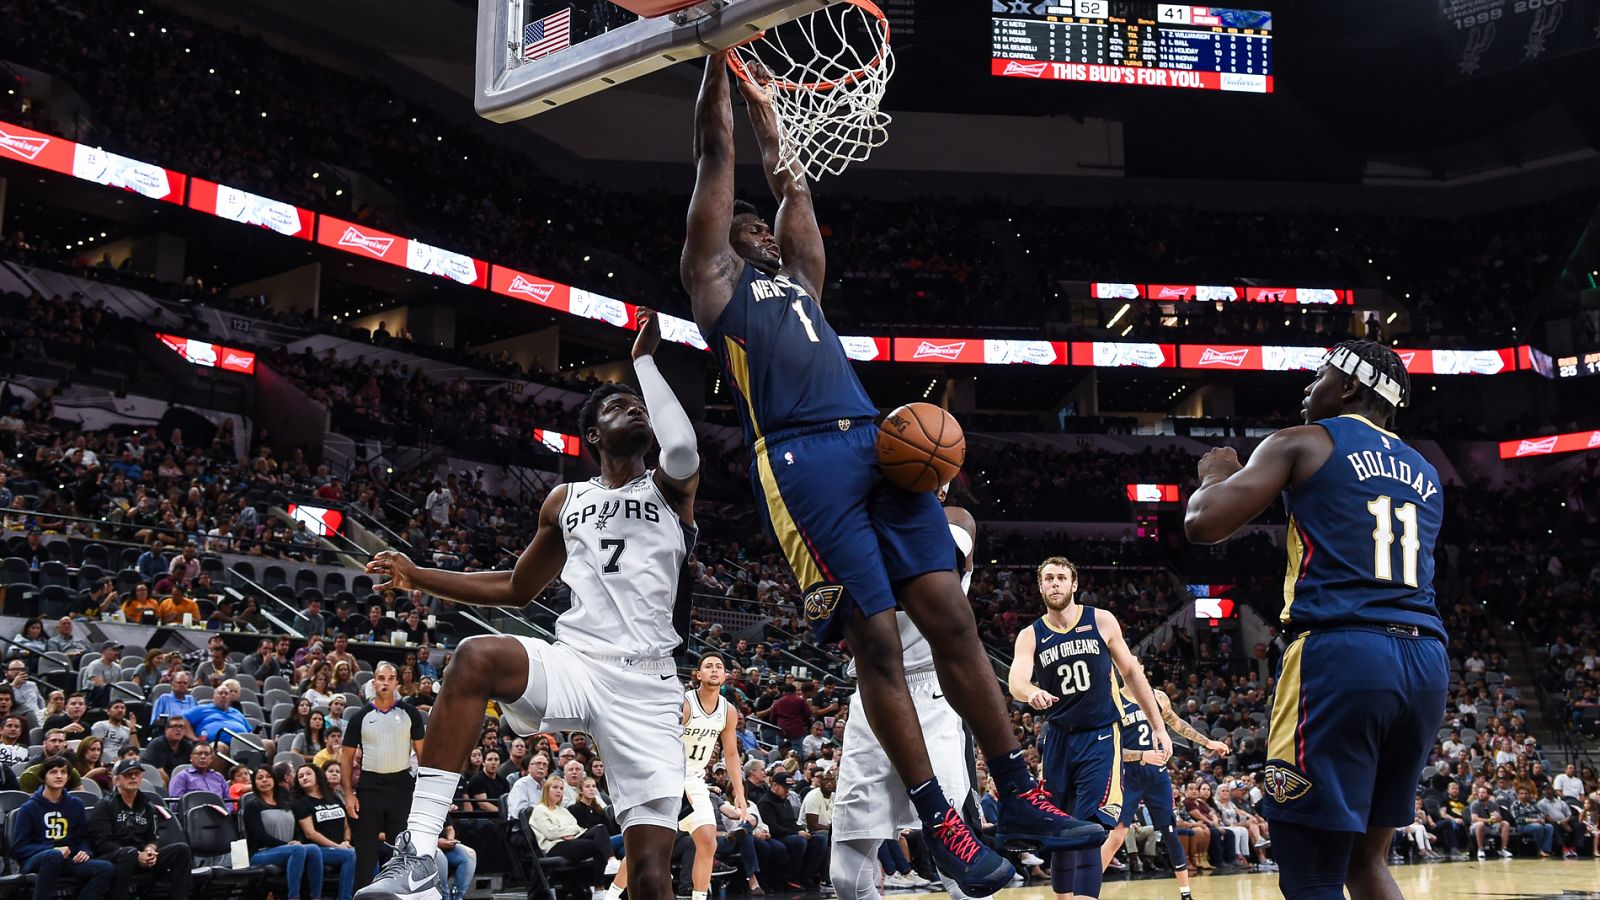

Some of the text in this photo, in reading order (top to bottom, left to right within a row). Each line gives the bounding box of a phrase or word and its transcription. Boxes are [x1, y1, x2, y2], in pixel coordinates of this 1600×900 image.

[1081, 2, 1100, 14] 52
[1164, 8, 1182, 20] 41
[1454, 8, 1503, 30] 1999
[1052, 63, 1204, 88] THIS BUD'S FOR YOU.
[345, 230, 388, 250] Budweiser
[514, 280, 548, 296] Budweiser
[792, 300, 820, 342] 1
[918, 344, 959, 356] Budweiser
[1203, 351, 1244, 362] Budweiser
[1347, 450, 1437, 502] HOLIDAY
[566, 500, 660, 533] SPURS
[1367, 495, 1420, 588] 11
[600, 538, 626, 574] 7
[1039, 639, 1100, 668] NEW ORLEANS
[1058, 660, 1091, 696] 20
[1138, 724, 1150, 746] 2
[689, 745, 706, 760] 11
